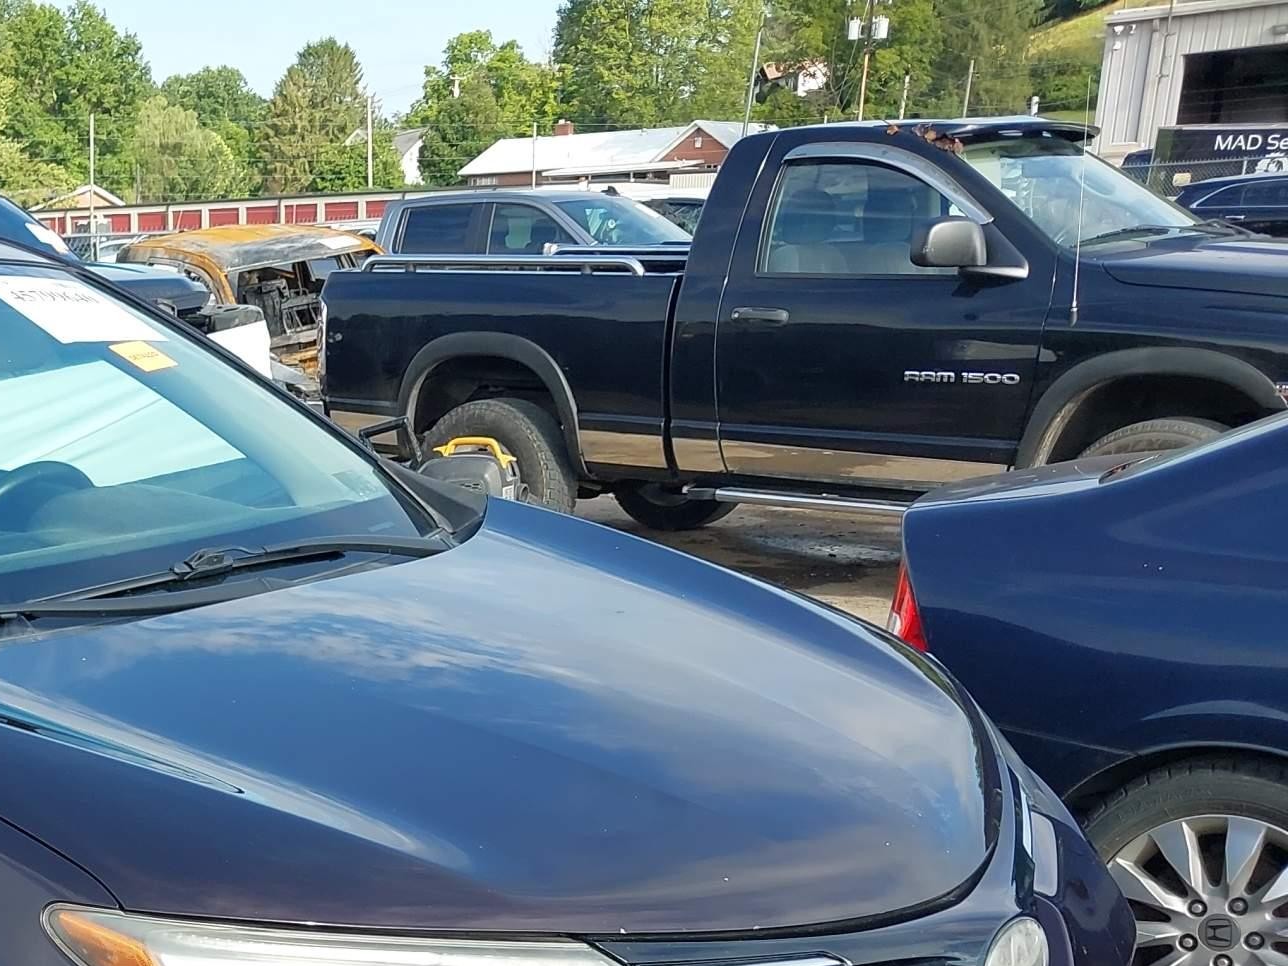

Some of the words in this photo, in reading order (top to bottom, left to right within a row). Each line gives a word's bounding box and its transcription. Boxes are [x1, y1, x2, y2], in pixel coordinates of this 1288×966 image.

[1213, 133, 1263, 151] MAD
[903, 370, 956, 383] RAM
[961, 372, 1021, 385] 1500
